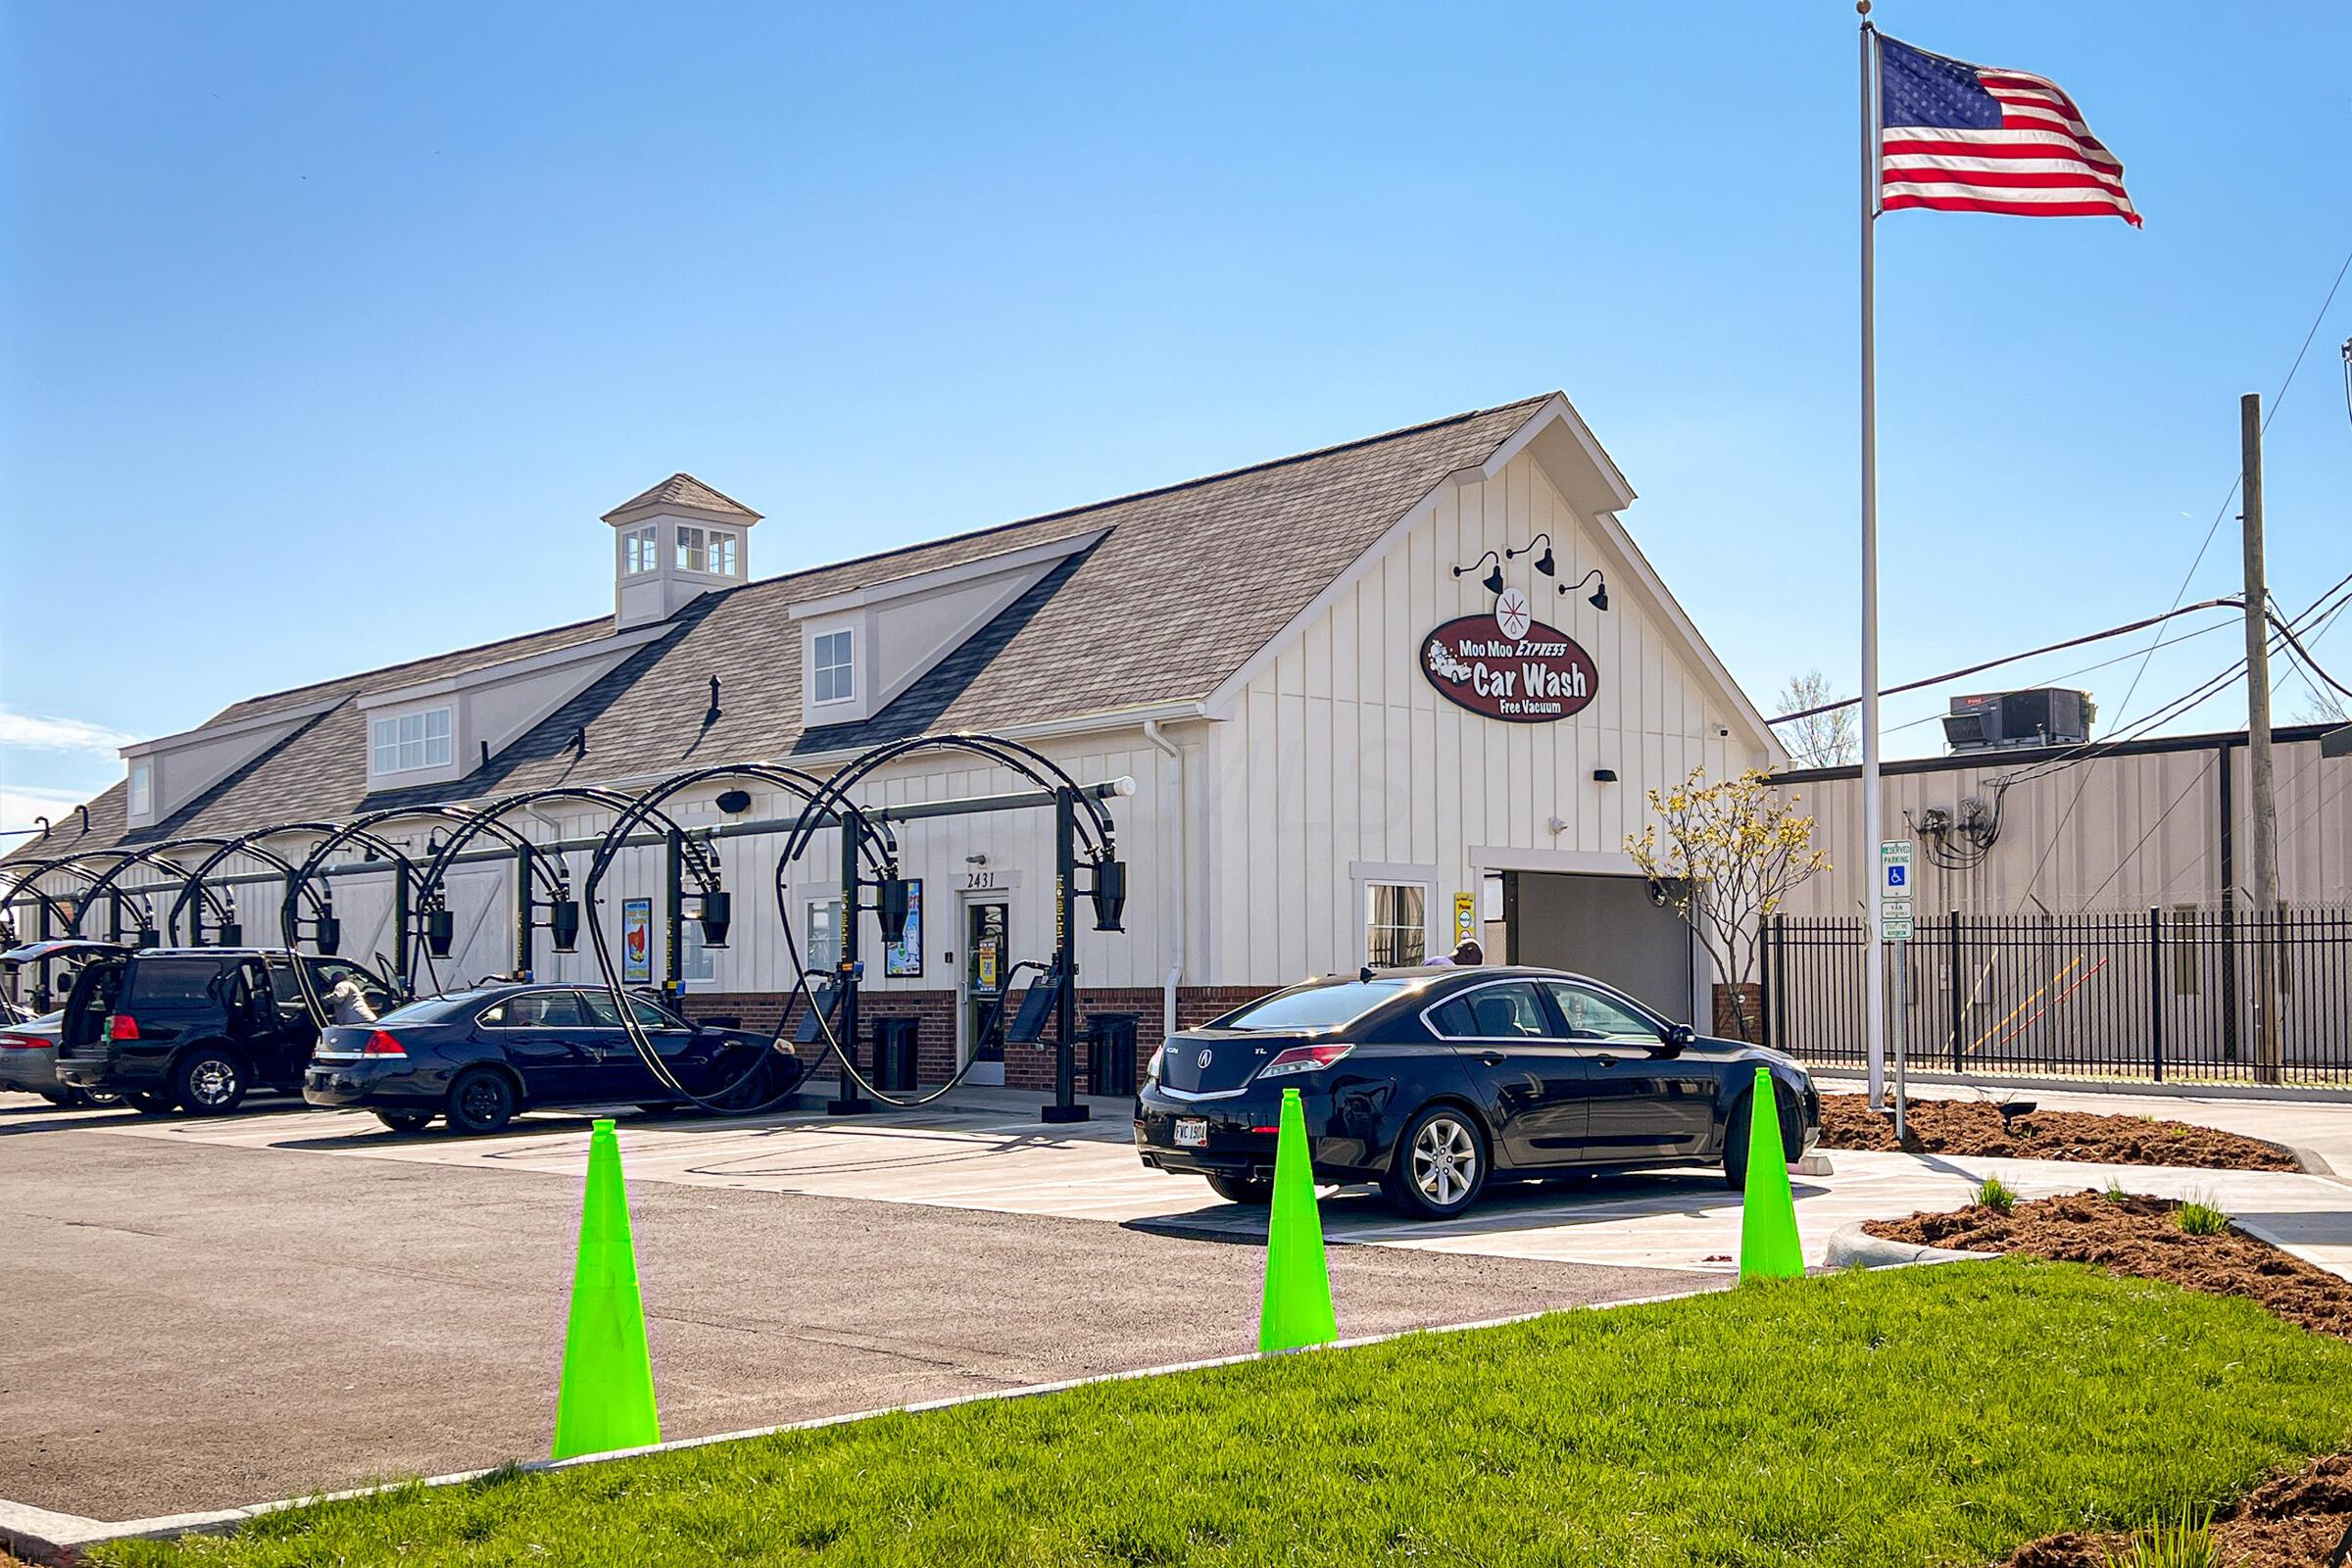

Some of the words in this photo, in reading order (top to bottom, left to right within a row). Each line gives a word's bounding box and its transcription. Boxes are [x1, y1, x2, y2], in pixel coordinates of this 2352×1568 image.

[1459, 639, 1486, 658] Moo
[1488, 640, 1513, 658] Moo
[1515, 640, 1568, 657] EXPRESS
[1473, 662, 1517, 698] Car
[1522, 662, 1587, 698] Wash
[1499, 700, 1520, 714] Free
[1522, 700, 1561, 714] Vacuum
[967, 872, 995, 888] 2431
